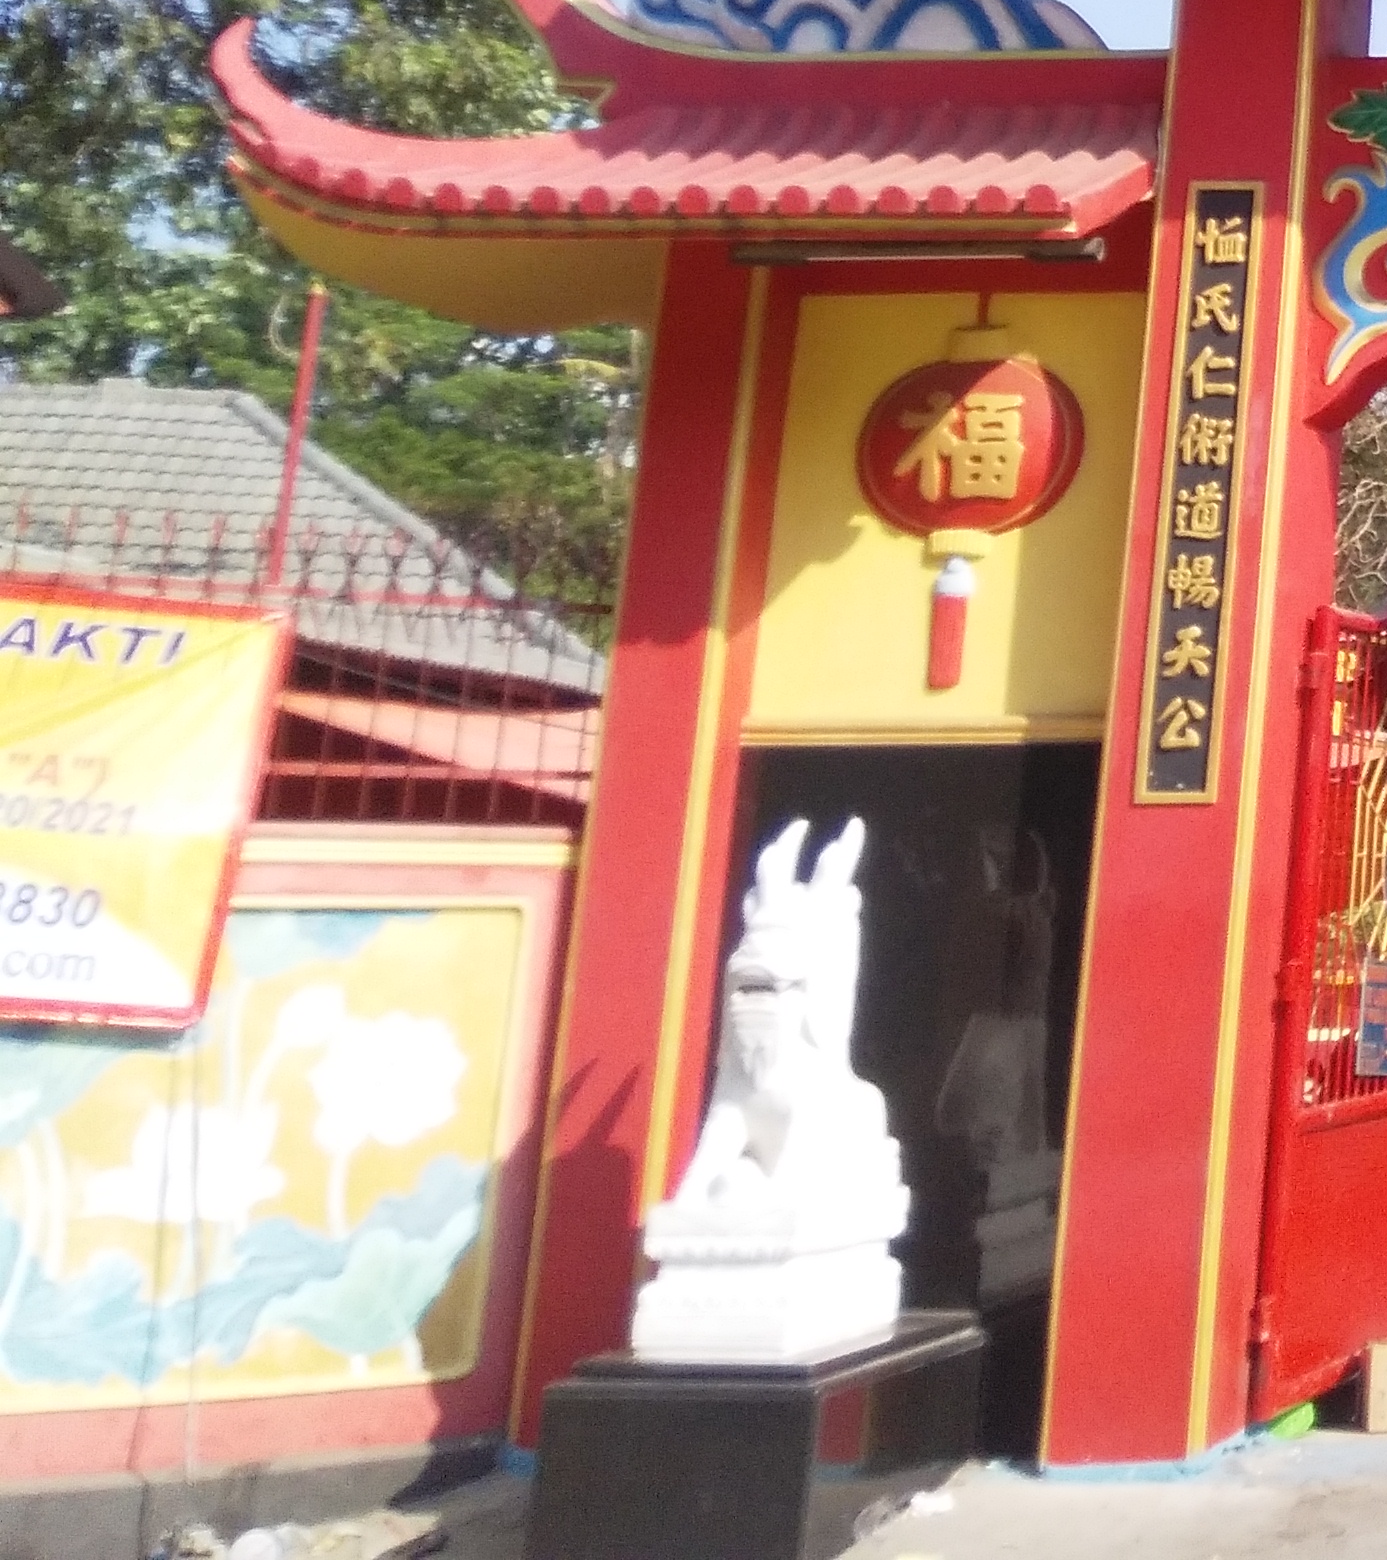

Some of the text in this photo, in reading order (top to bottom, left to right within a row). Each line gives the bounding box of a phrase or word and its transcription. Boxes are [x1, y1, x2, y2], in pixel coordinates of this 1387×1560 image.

[893, 392, 1025, 503] 福
[0, 617, 186, 666] AKTI
[0, 881, 101, 929] 830
